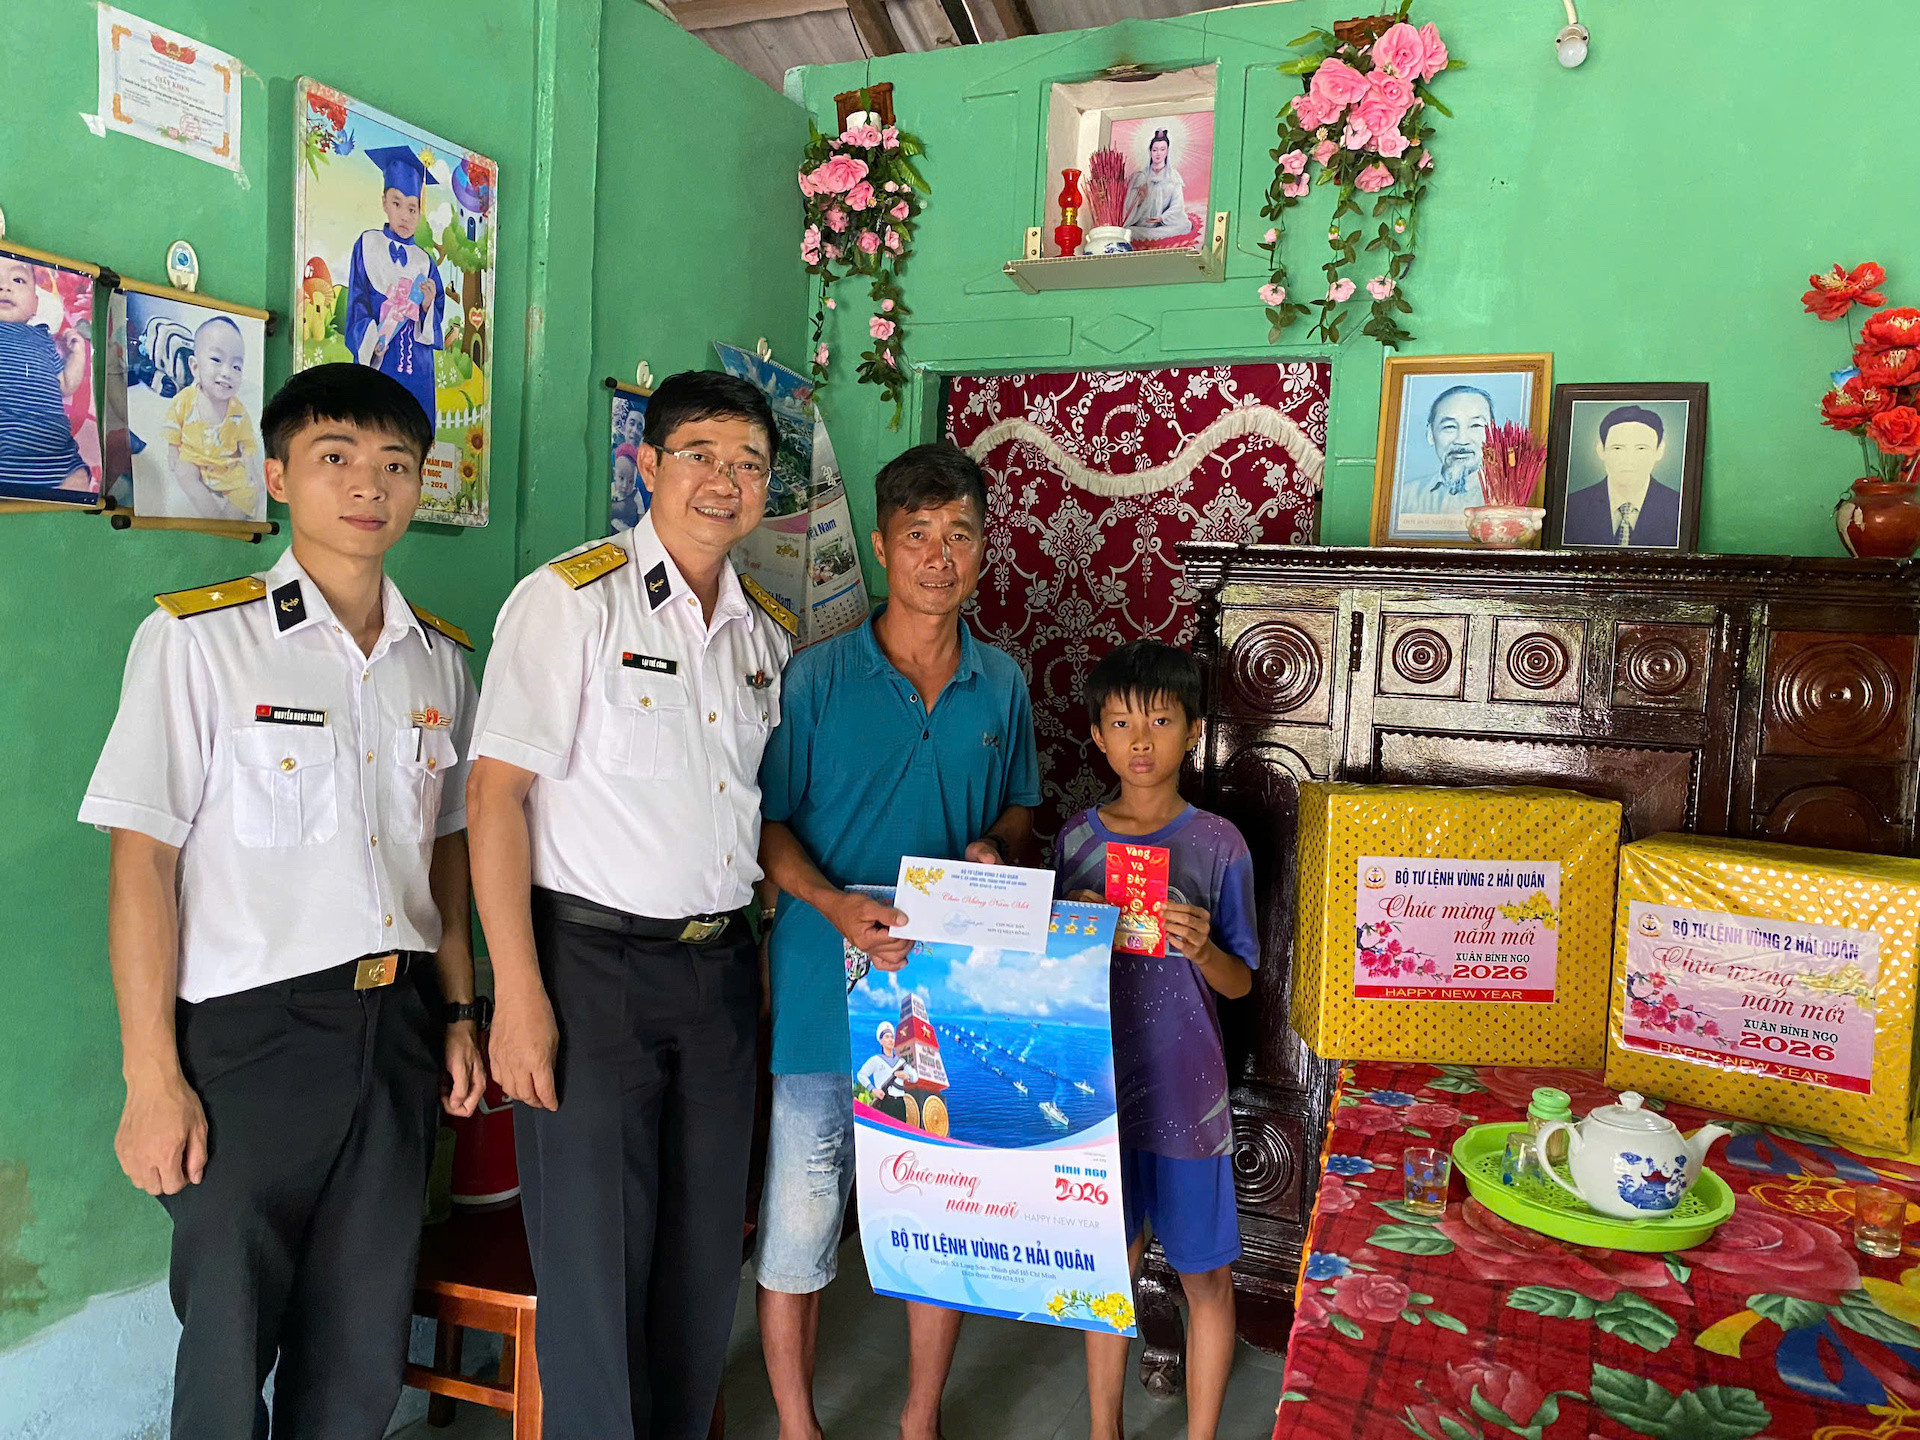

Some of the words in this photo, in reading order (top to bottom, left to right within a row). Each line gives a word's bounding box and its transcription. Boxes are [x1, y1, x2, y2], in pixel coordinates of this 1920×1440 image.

[431, 481, 448, 490] 2024
[818, 518, 836, 534] Nam
[1126, 846, 1150, 860] Vàng
[1396, 868, 1408, 888] BỘ
[1412, 870, 1425, 885] TƯ
[1428, 868, 1454, 889] LỆNH
[1457, 868, 1484, 887] VÙNG
[1488, 873, 1494, 887] 2
[1497, 868, 1514, 888] HẢI
[1517, 870, 1545, 889] QUÂN
[1378, 894, 1436, 918] Chúc
[1442, 901, 1496, 930] mừng
[1454, 928, 1496, 945] năm
[1501, 926, 1536, 946] mới
[1672, 918, 1688, 940] BỘ
[1692, 922, 1708, 938] TƯ
[1710, 924, 1743, 945] LỆNH
[1746, 928, 1780, 950] VÙNG
[1784, 936, 1792, 950] 2
[1795, 932, 1818, 956] HẢI
[1822, 938, 1859, 961] QUÂN
[1455, 950, 1482, 962] XUÂN
[1485, 951, 1508, 963] BÍNH
[1510, 954, 1530, 966] NGỌ
[1653, 946, 1719, 975] Chúc
[1452, 964, 1528, 980] 2026
[1386, 988, 1438, 998] HAPPY
[1441, 989, 1476, 999] NEW
[1480, 990, 1523, 1000] YEAR
[1741, 993, 1796, 1016] năm
[1800, 1002, 1847, 1024] mới
[1744, 1018, 1776, 1033] XUÂN
[1780, 1022, 1809, 1038] BÍNH
[1812, 1030, 1839, 1046] NGỌ
[1739, 1031, 1836, 1062] 2026
[1658, 1042, 1722, 1062] HAPPY
[1723, 1056, 1769, 1072] NEW
[1775, 1065, 1828, 1084] YEAR
[878, 1150, 934, 1196] Chúc
[935, 1168, 981, 1198] mừng
[1054, 1163, 1080, 1175] BÍNH
[1084, 1168, 1107, 1179] NGỌ
[1054, 1176, 1109, 1206] 2026
[945, 1197, 984, 1215] năm
[984, 1200, 1020, 1219] mới
[1024, 1213, 1050, 1225] HAPPY
[1053, 1216, 1078, 1226] NEW
[1077, 1218, 1100, 1229] YEAR
[891, 1228, 909, 1252] BỘ
[912, 1232, 930, 1251] TƯ
[933, 1233, 968, 1257] LỆNH
[971, 1236, 1009, 1262] VÙNG
[1013, 1246, 1022, 1263] 2
[1026, 1240, 1050, 1266] HẢI
[1054, 1248, 1096, 1272] QUÂN
[991, 1266, 1008, 1274] Thành
